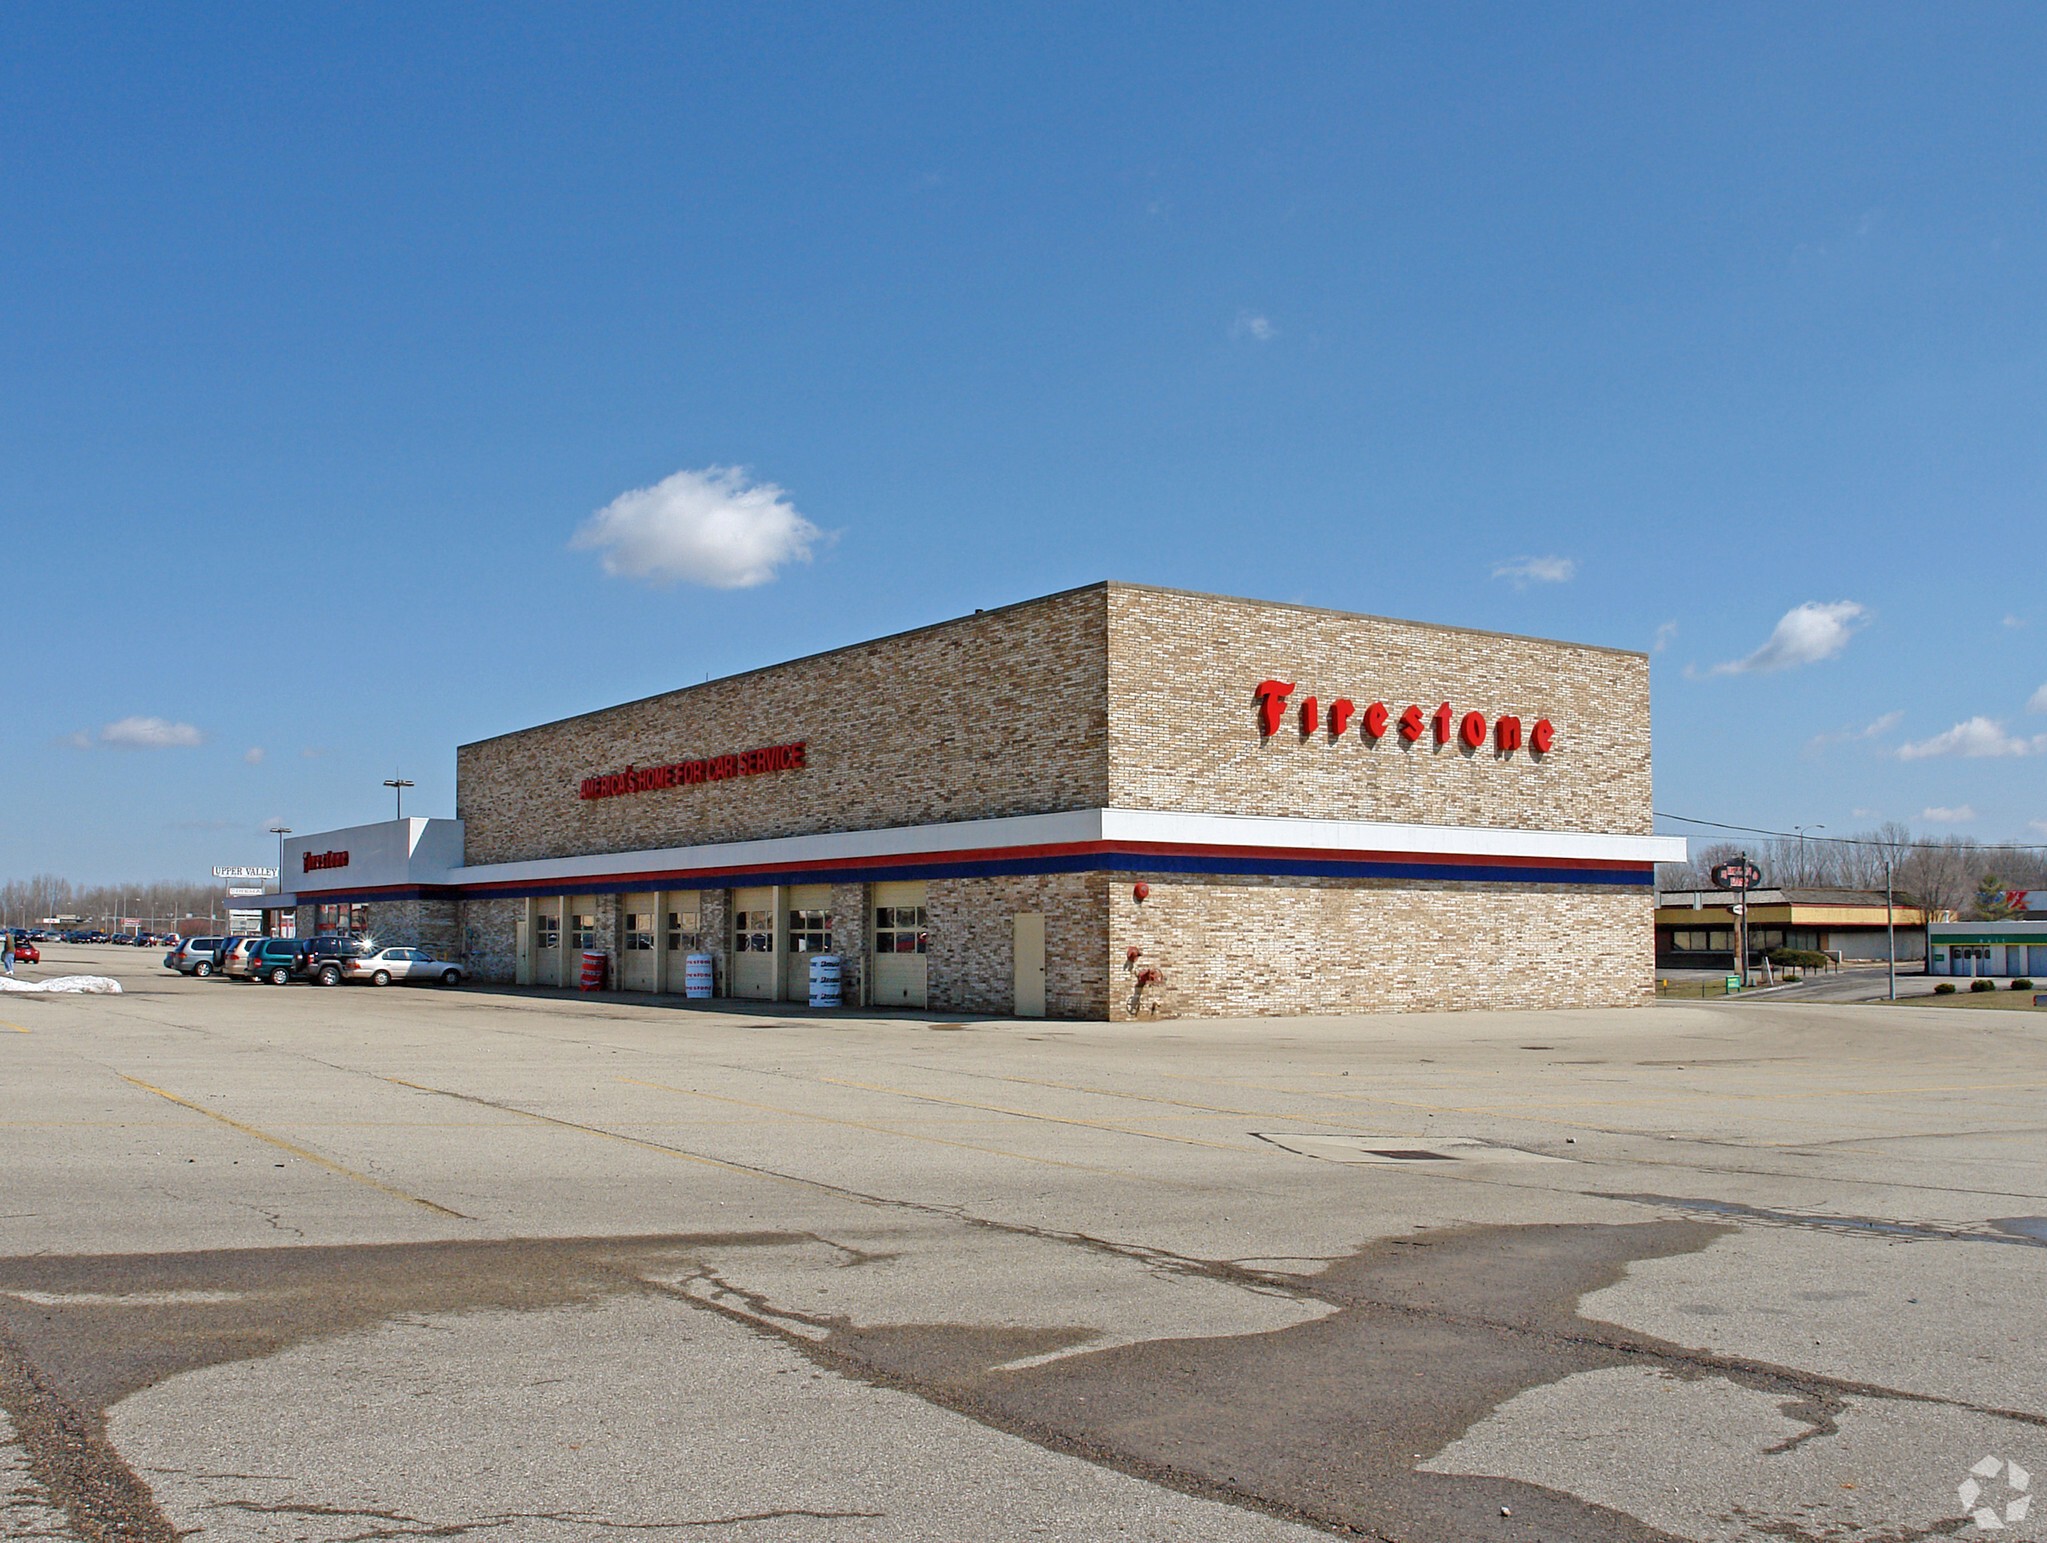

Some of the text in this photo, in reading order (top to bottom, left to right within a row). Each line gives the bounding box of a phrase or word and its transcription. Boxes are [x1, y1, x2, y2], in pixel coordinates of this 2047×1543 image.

[1254, 679, 1556, 753] Firestone
[580, 742, 806, 800] AMERICA'S HOME FOR CAR SERVICE
[215, 866, 278, 876] UPPER VALLEY
